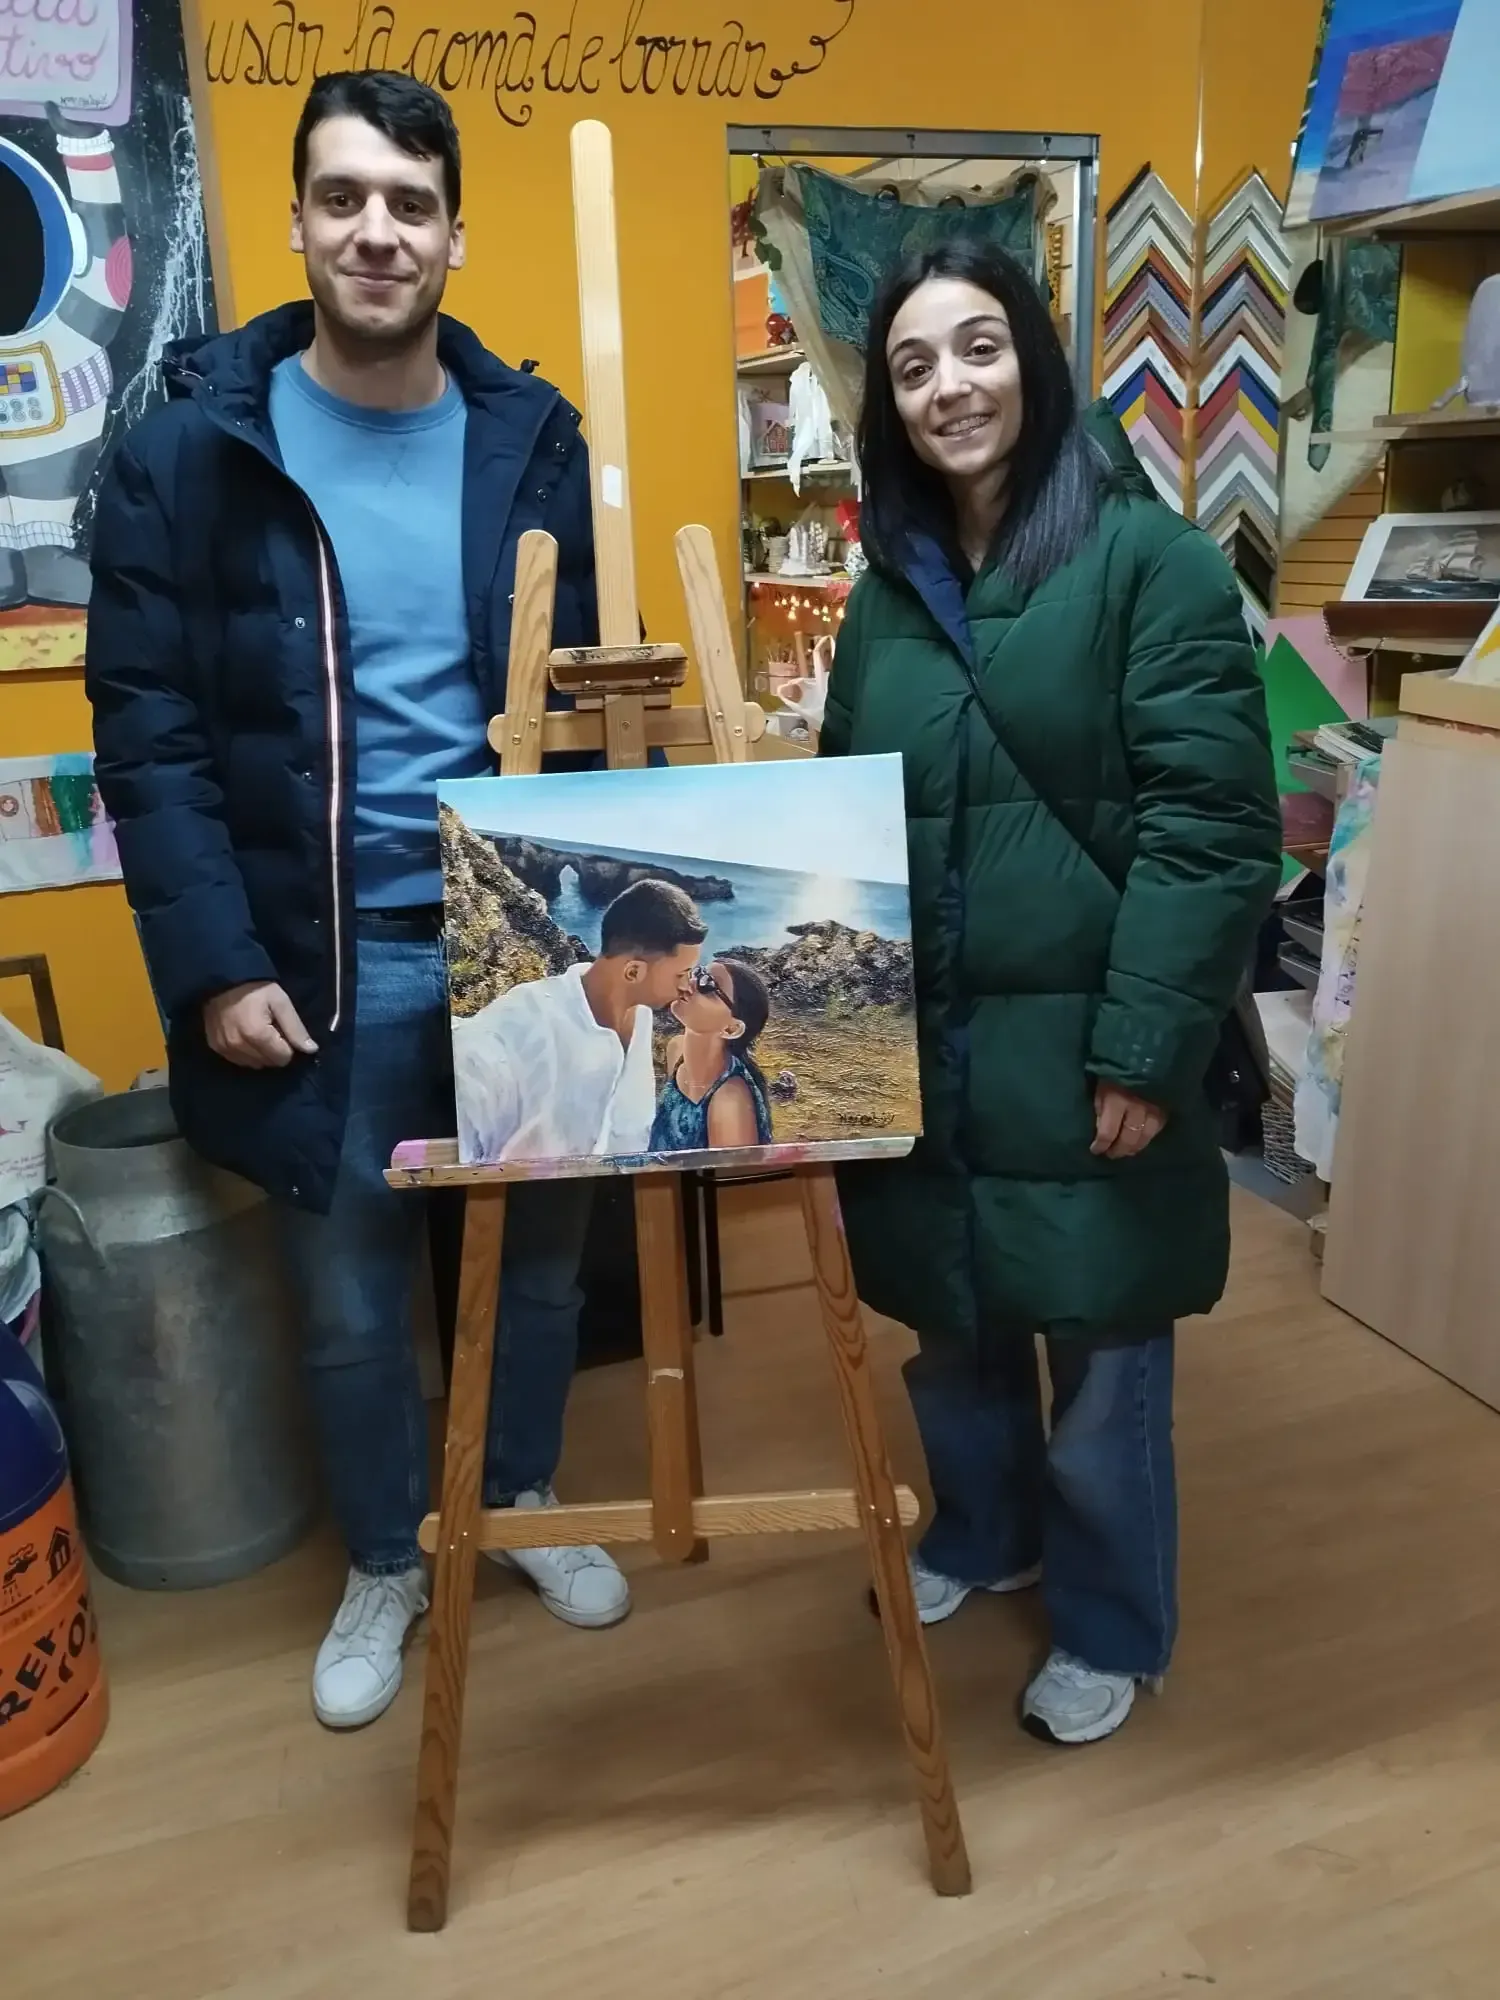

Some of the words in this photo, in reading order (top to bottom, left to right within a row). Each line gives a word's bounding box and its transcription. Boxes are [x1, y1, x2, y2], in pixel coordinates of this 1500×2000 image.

[205, 0, 324, 86] usar
[541, 0, 603, 94] de
[609, 0, 815, 99] borrar
